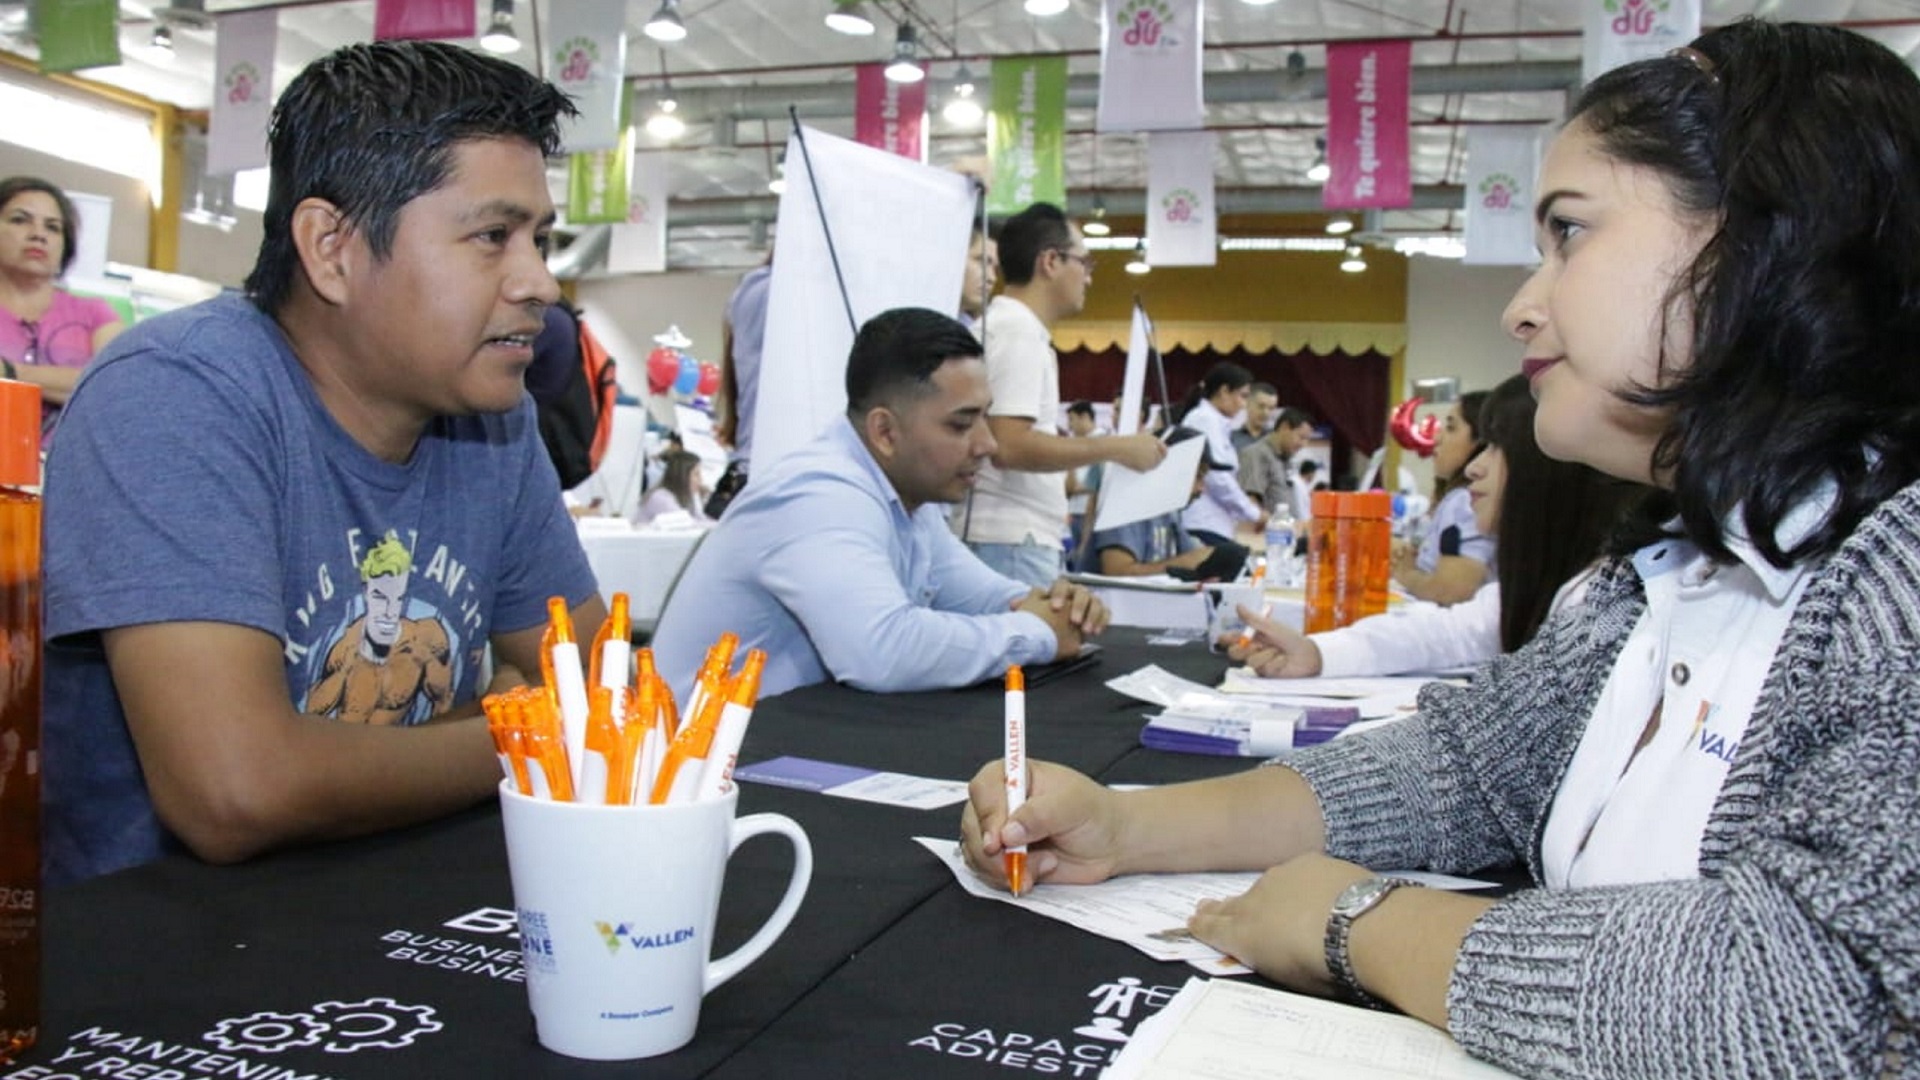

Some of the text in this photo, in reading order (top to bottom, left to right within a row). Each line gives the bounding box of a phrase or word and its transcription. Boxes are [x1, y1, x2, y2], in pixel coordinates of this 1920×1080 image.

[1354, 106, 1381, 173] quiere
[1354, 175, 1377, 199] Te
[380, 929, 525, 965] BUSINE
[631, 926, 695, 949] VALLEN
[50, 1046, 97, 1065] Y
